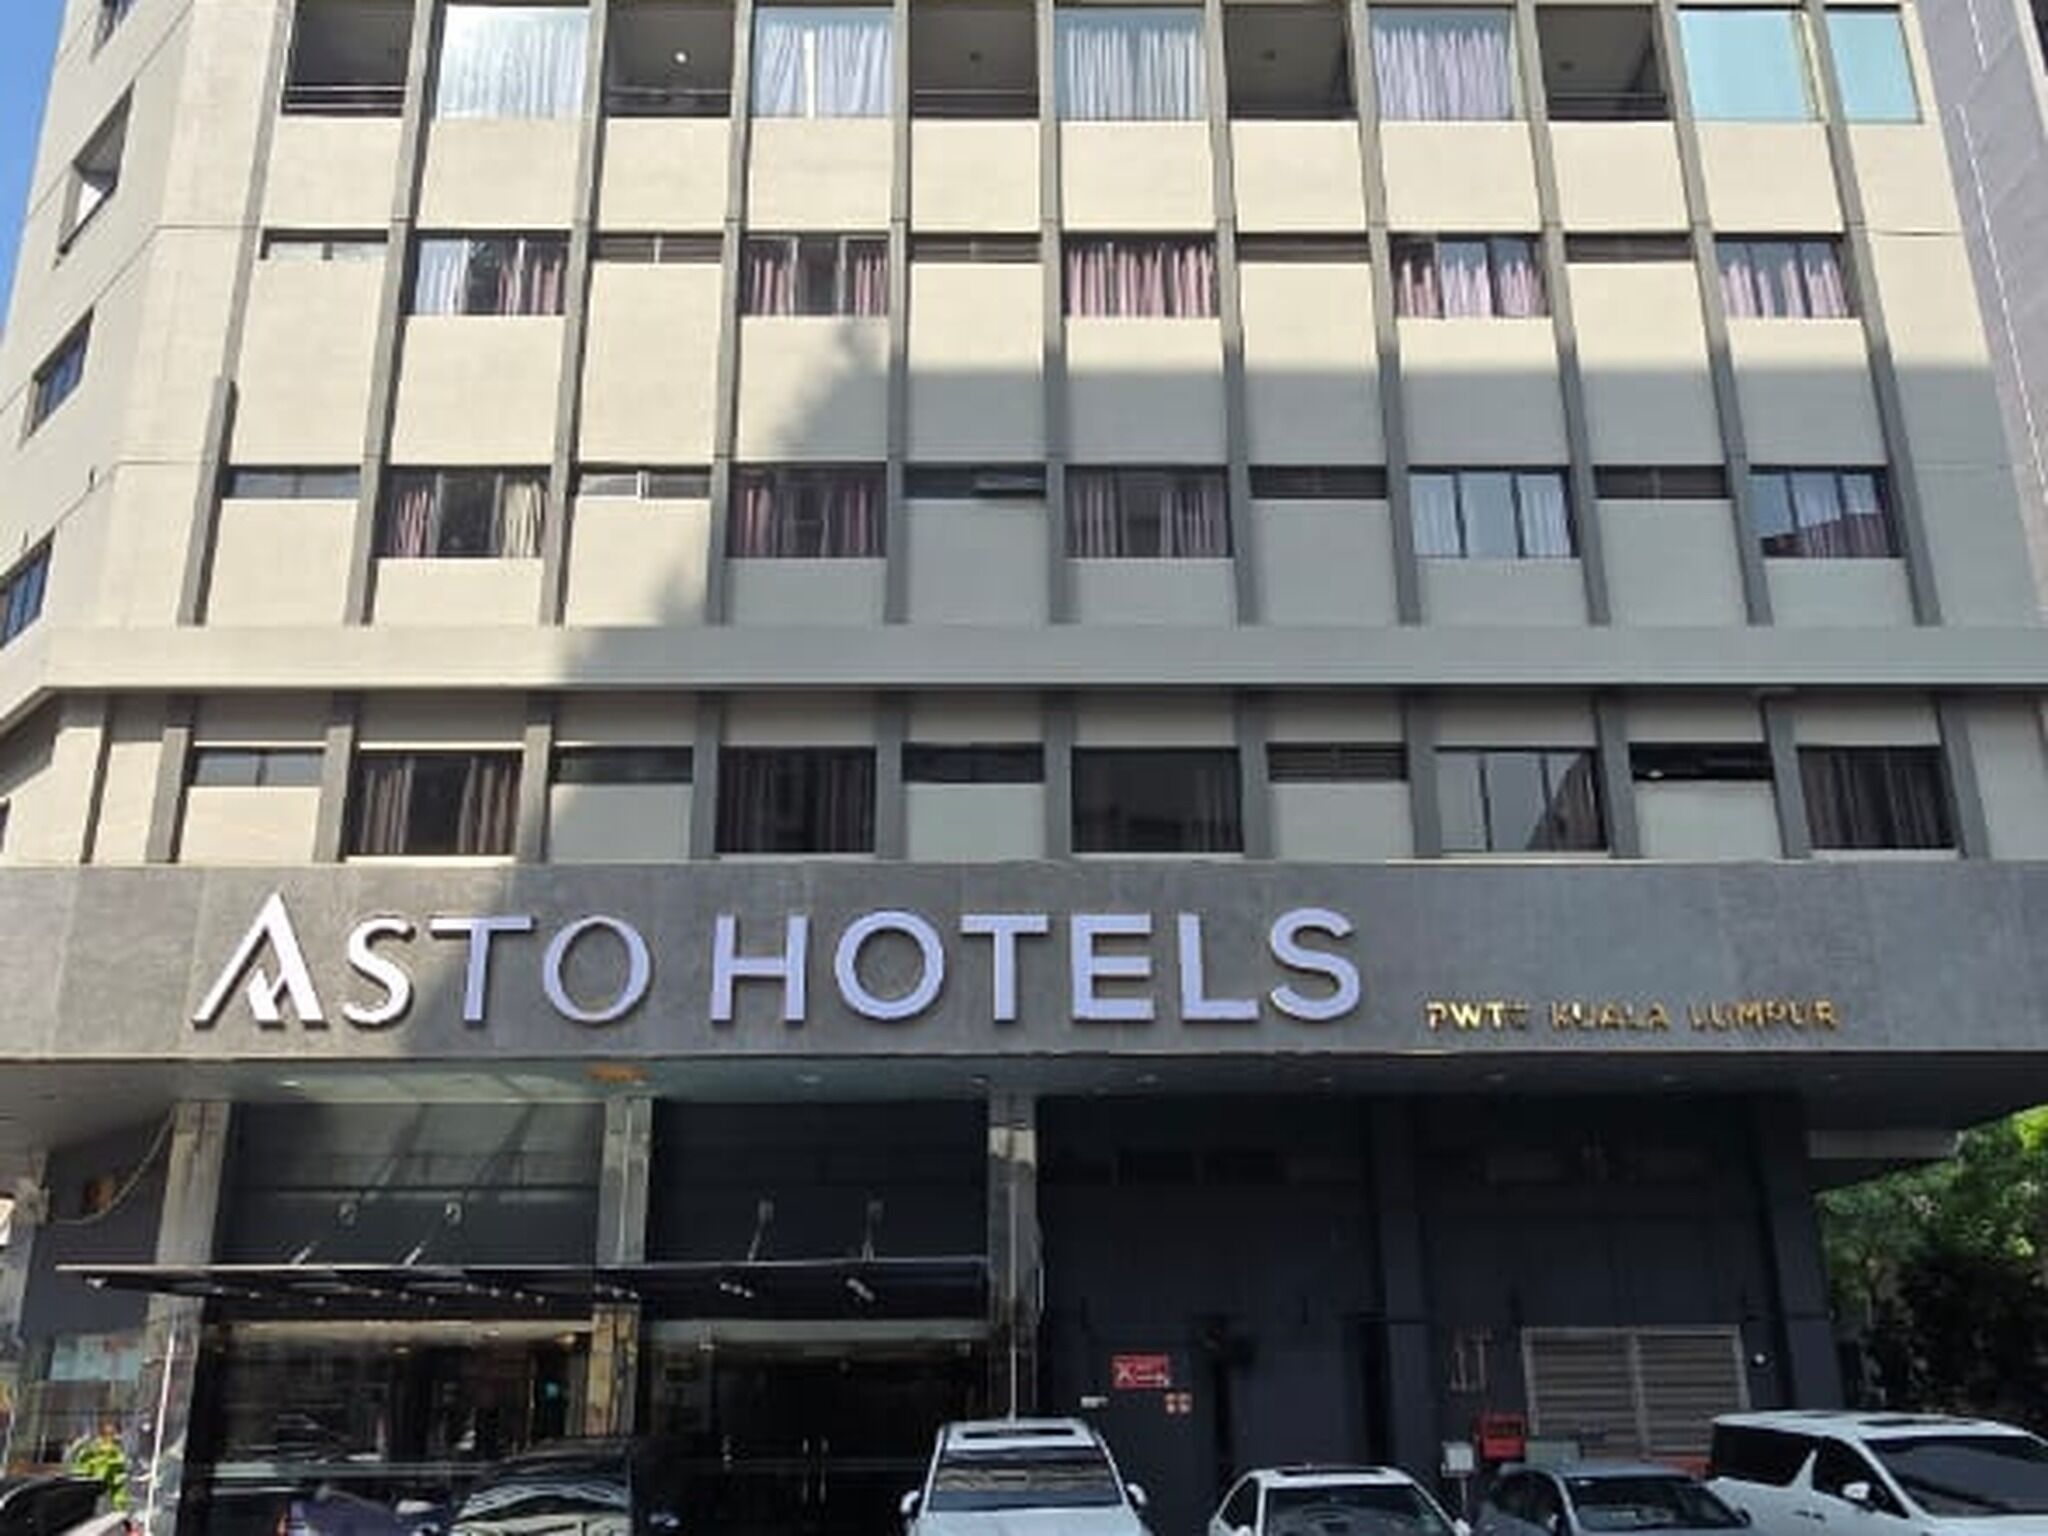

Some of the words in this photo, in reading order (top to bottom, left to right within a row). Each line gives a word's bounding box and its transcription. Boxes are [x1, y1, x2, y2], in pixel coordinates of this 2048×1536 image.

[192, 891, 653, 1029] ASTO
[709, 907, 1363, 1022] HOTELS
[1551, 1000, 1670, 1030] KUALA
[1688, 999, 1838, 1029] LUMPUR
